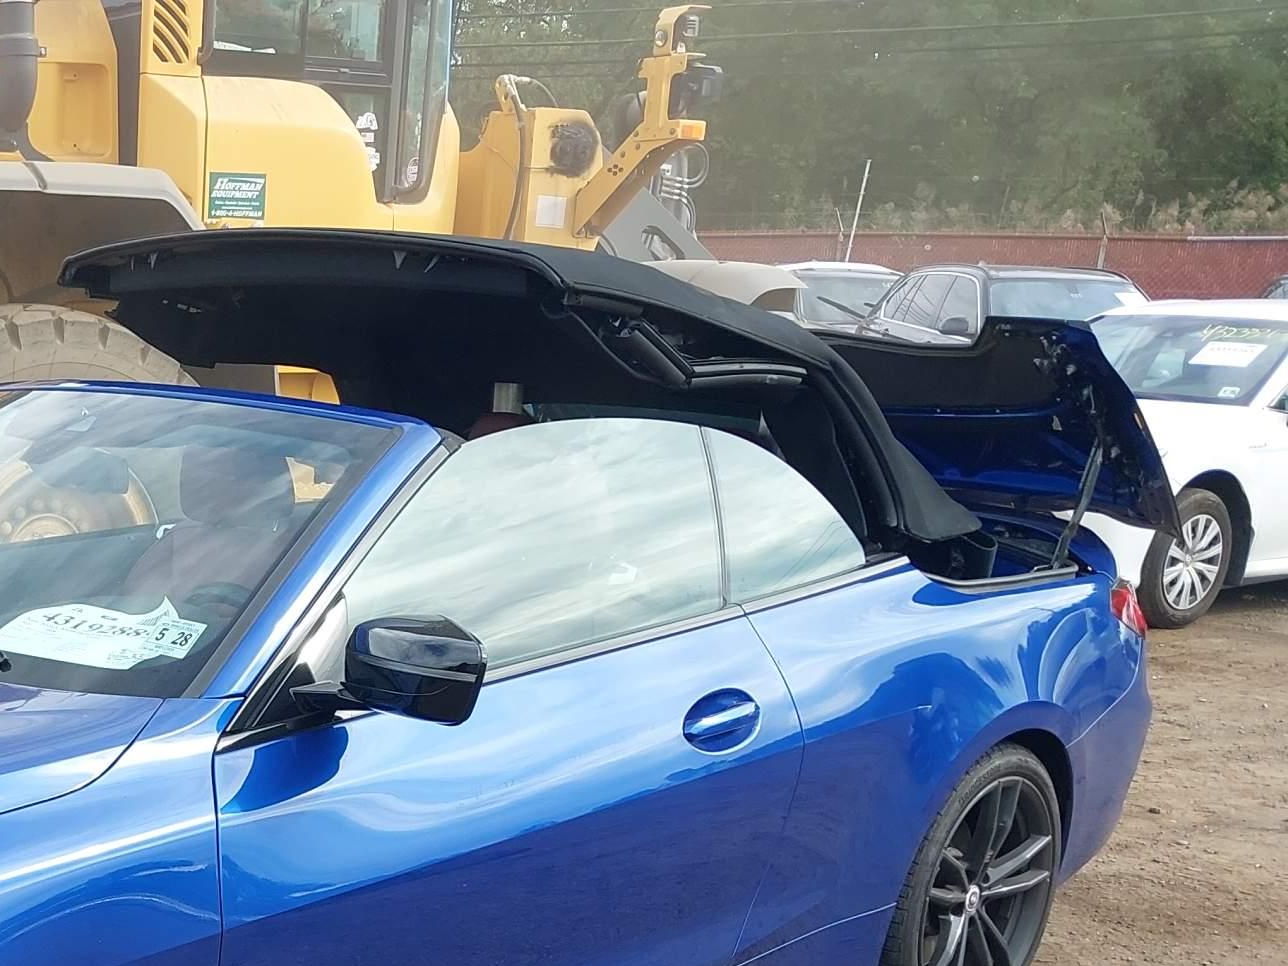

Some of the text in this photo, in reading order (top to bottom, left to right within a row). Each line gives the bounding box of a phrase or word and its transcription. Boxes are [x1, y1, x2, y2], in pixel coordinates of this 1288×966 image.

[41, 613, 151, 637] 4319288
[154, 627, 194, 647] 5 28
